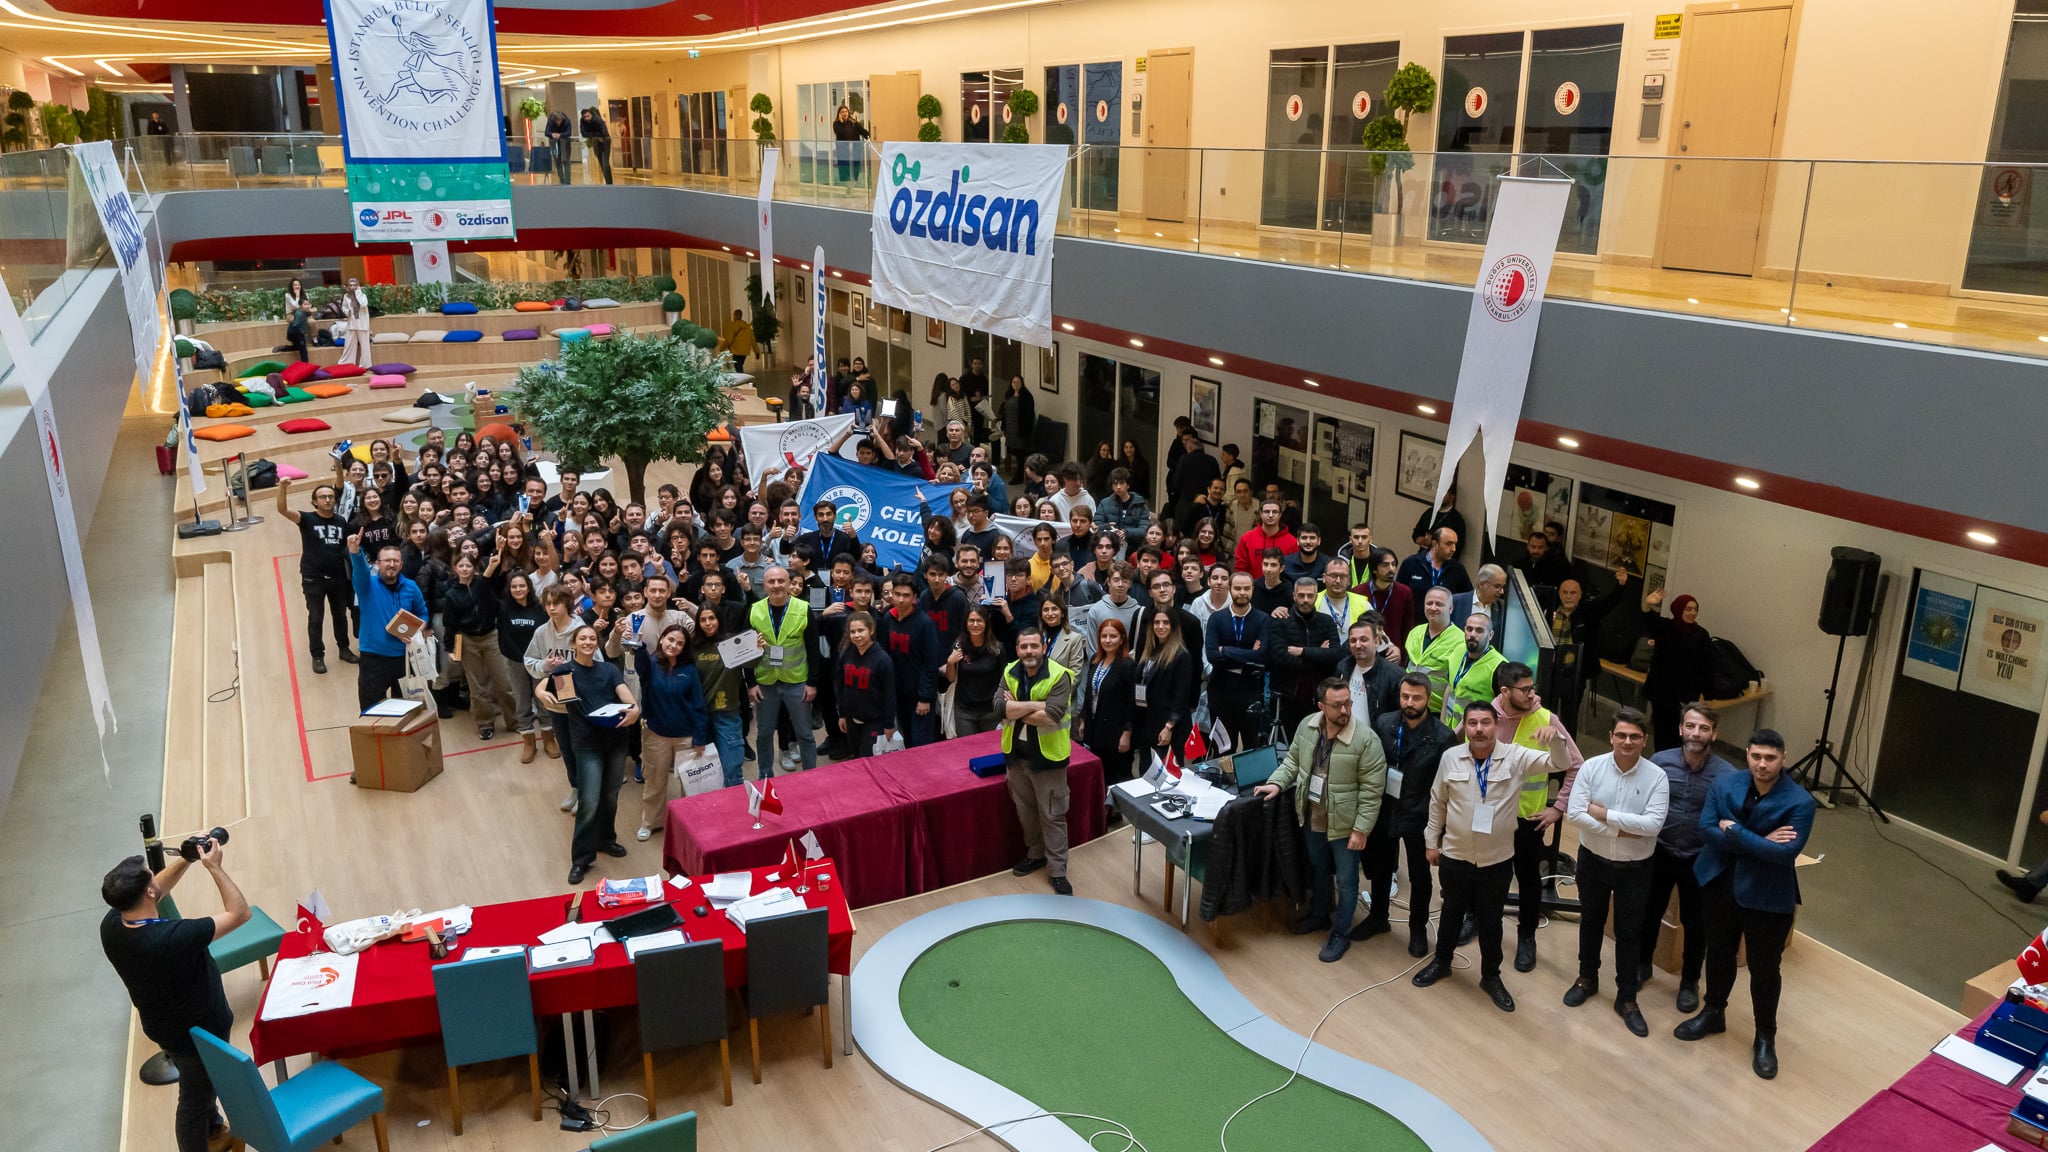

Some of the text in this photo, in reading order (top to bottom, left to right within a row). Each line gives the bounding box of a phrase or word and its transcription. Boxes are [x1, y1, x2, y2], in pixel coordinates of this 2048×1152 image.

[349, 1, 481, 64] İSTANBUL BULUŞ ŞENLİĞİ
[353, 76, 482, 132] INVENTION CHALLENGE
[889, 152, 1039, 257] özdisan
[382, 210, 413, 220] JPL
[456, 212, 509, 226] özdisan
[816, 268, 827, 413] özdisan
[870, 526, 925, 547] KOLE
[1992, 614, 2037, 633] BIG BROTHER
[1986, 649, 2028, 668] IS WATCHING
[1997, 661, 2014, 680] YOU
[686, 762, 714, 777] özdisan
